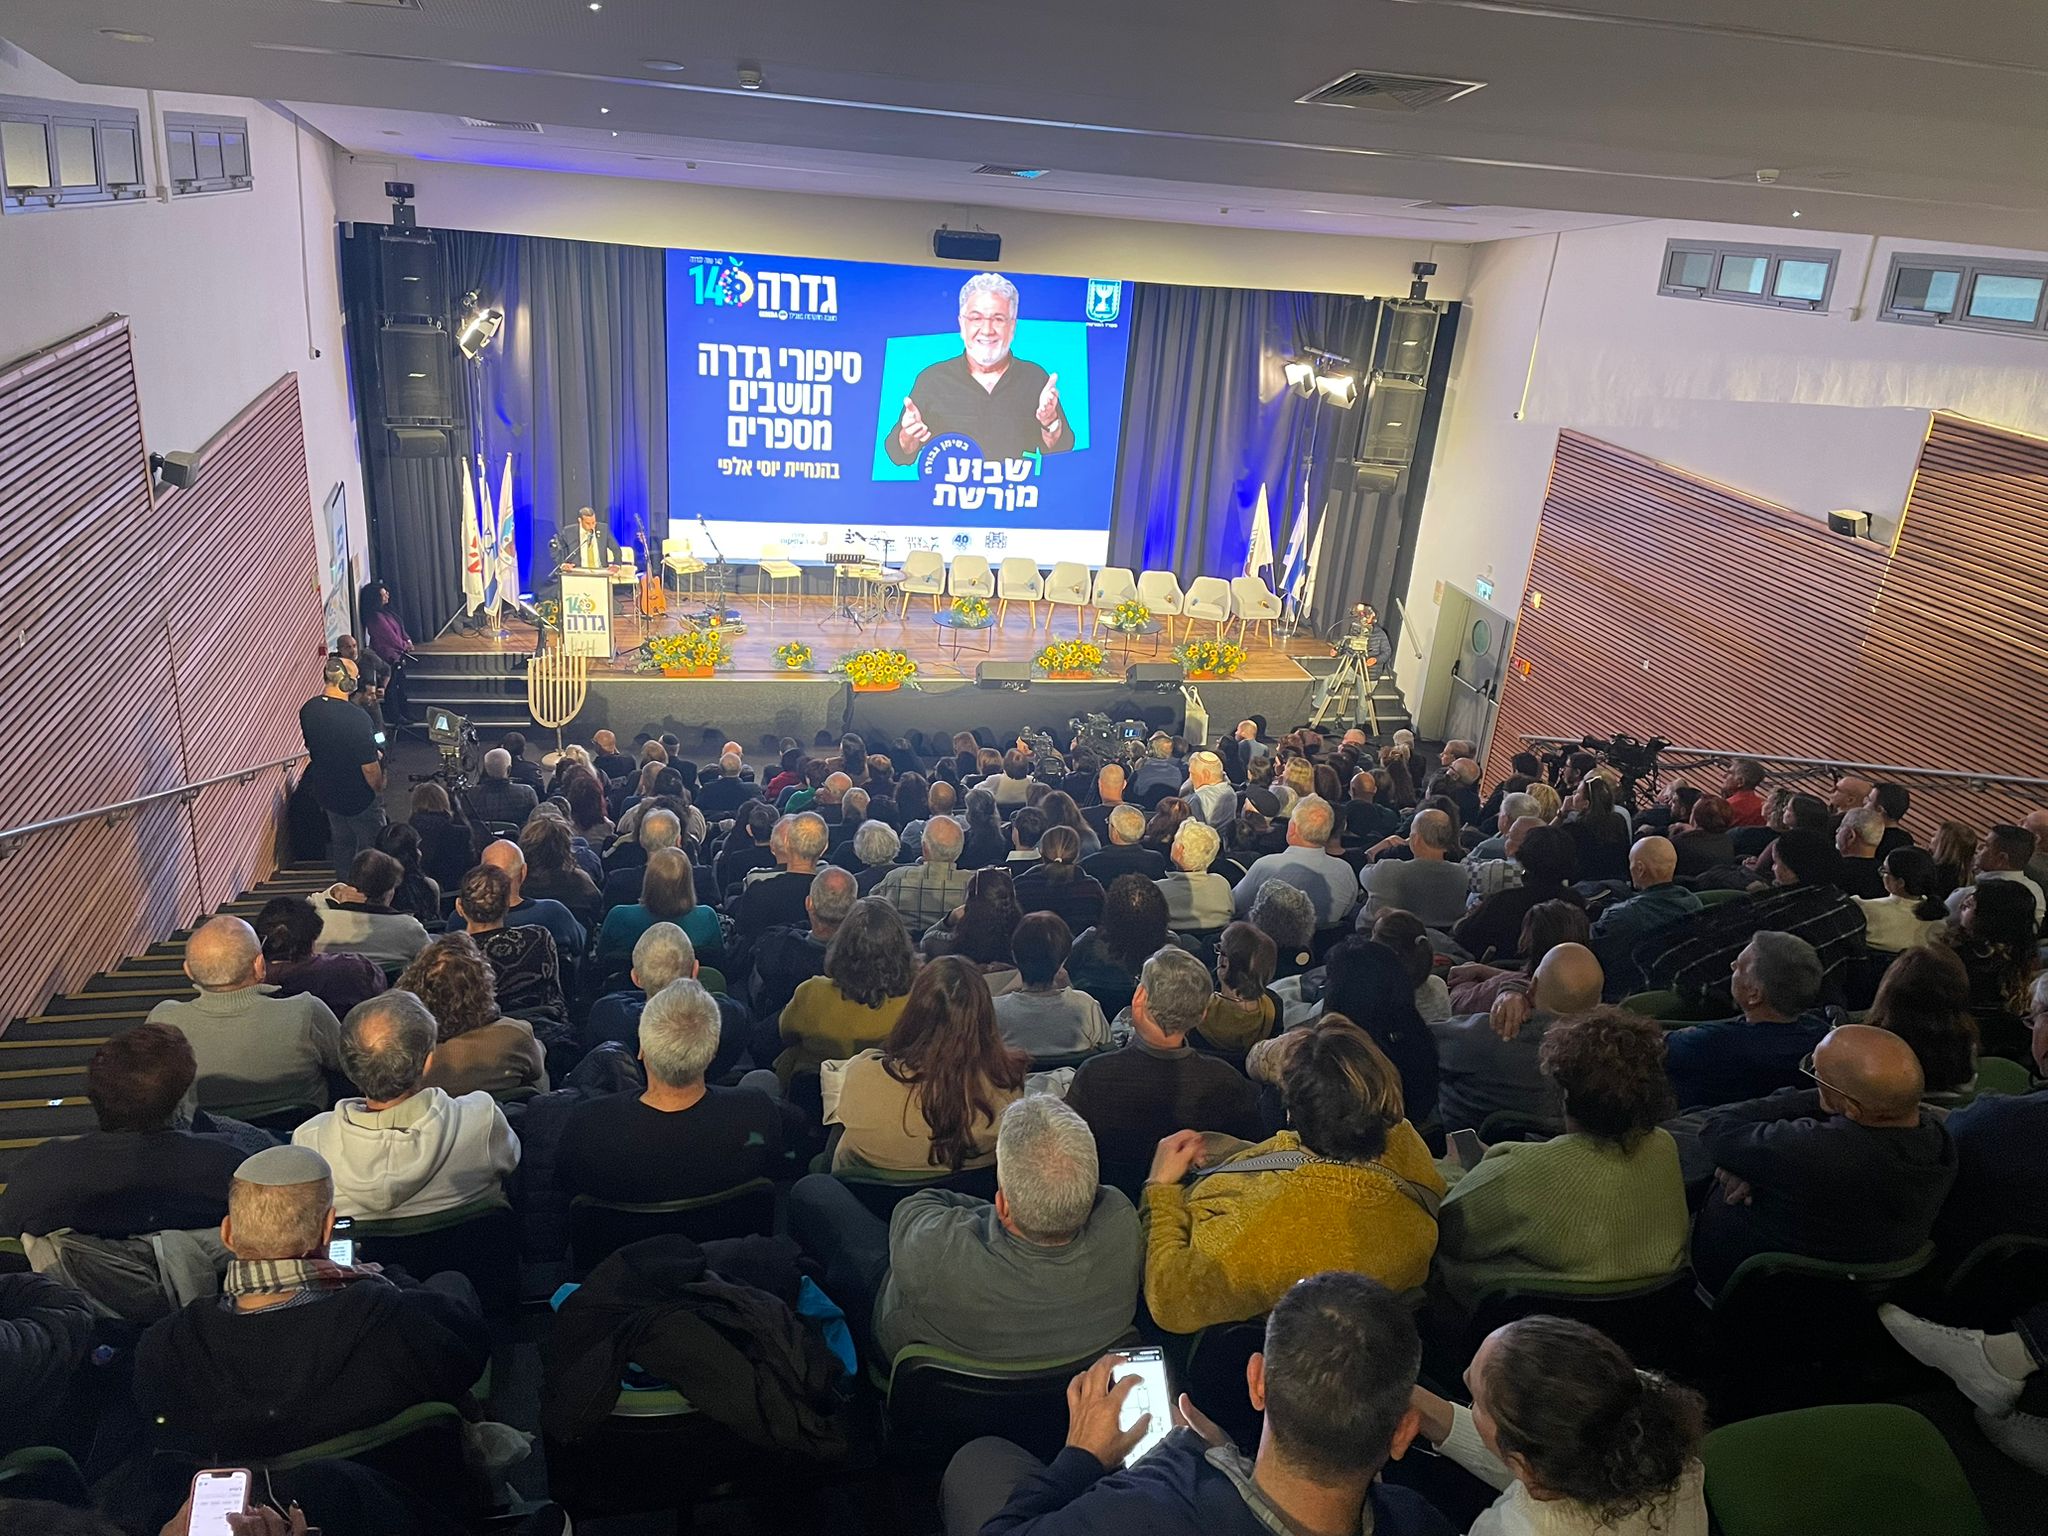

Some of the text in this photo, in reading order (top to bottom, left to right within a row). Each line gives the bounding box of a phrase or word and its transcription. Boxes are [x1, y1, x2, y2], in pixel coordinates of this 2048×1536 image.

[757, 271, 837, 314] גדרה
[698, 342, 863, 384] סיפורי גדרה
[728, 379, 833, 416] תושבים
[727, 415, 833, 451] מספרים
[717, 456, 841, 480] בהנחיית יוסי אלפי
[924, 439, 969, 475] בסימן גבורה
[953, 534, 969, 544] 40
[566, 614, 606, 631] גדרה
